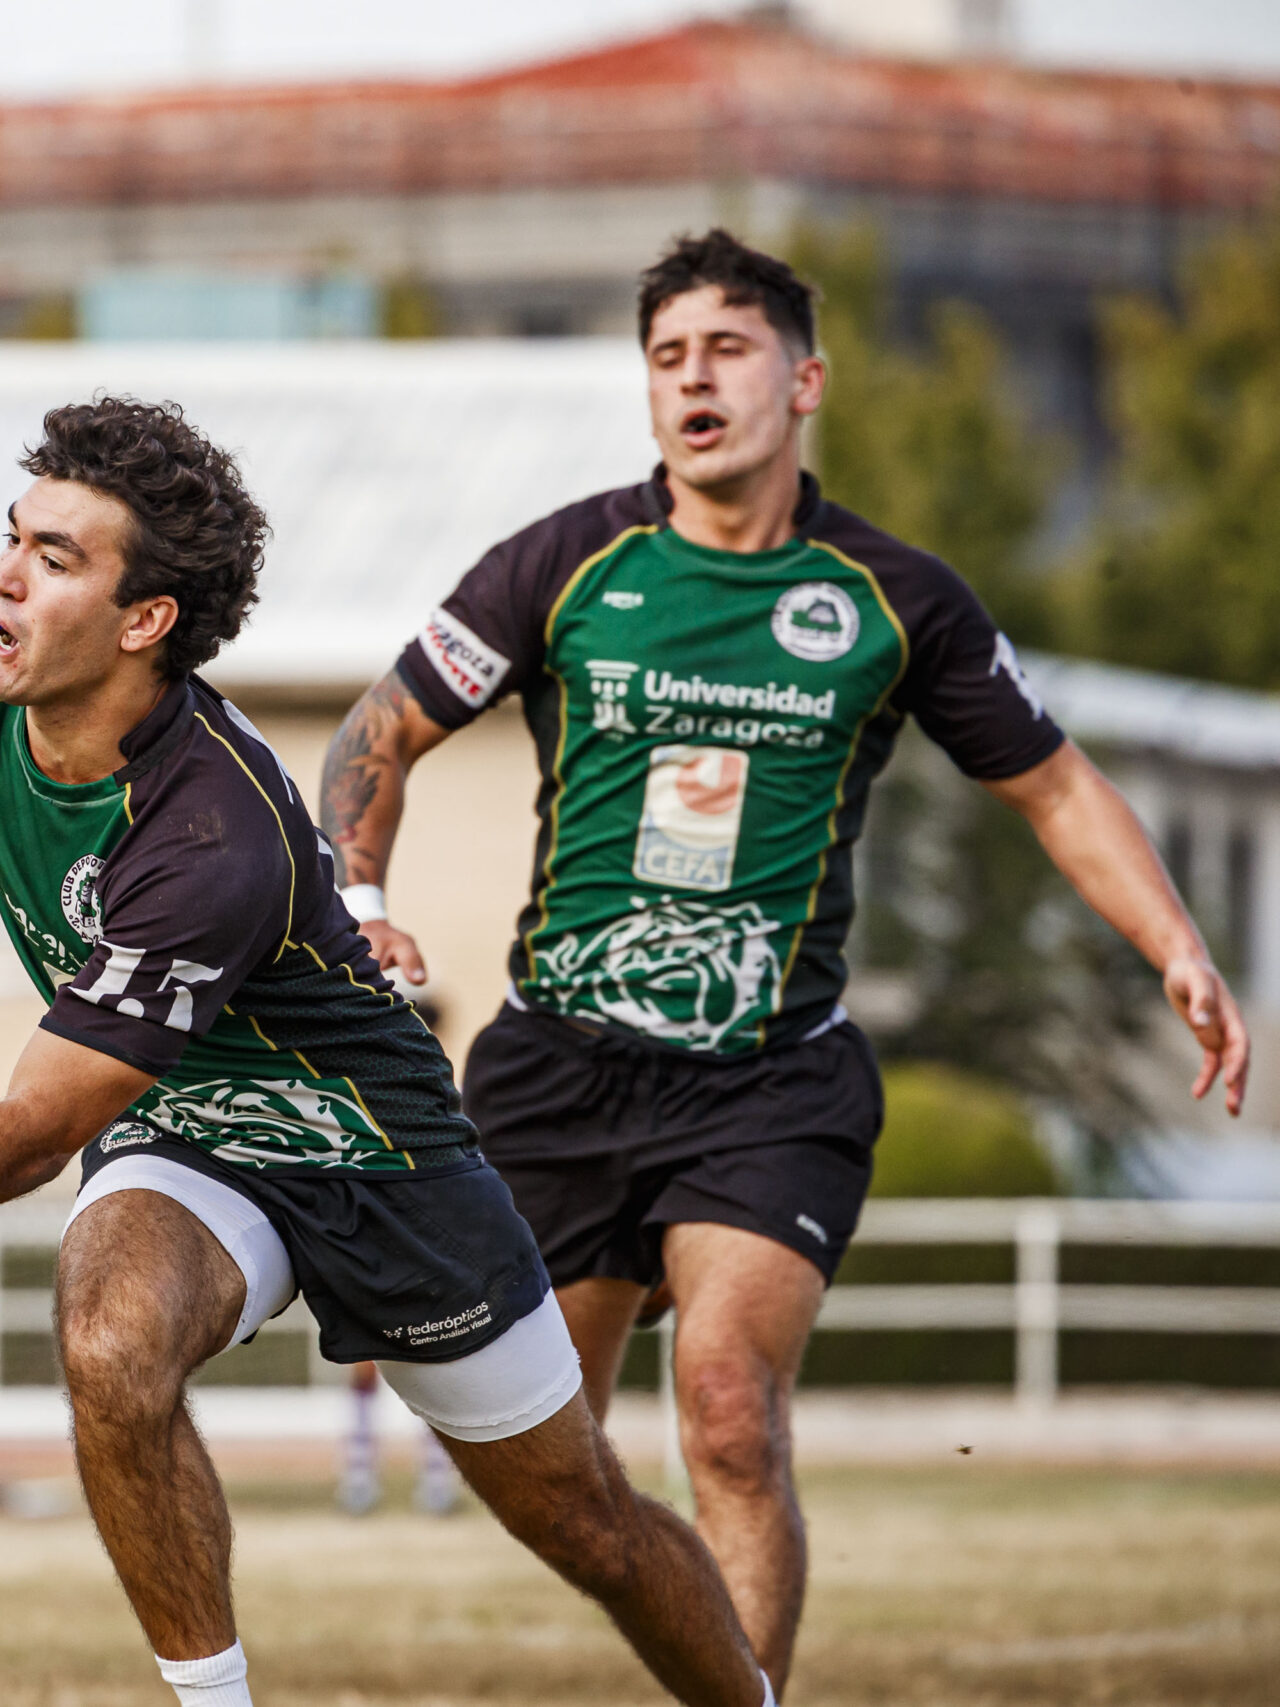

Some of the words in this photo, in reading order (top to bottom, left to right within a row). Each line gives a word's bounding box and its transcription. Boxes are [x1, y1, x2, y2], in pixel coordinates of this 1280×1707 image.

[644, 669, 836, 720] Universidad
[645, 704, 824, 748] Zaragoza
[643, 846, 721, 884] CEFA
[63, 876, 75, 907] CLUB
[407, 1301, 489, 1336] federópticos
[410, 1336, 438, 1346] Centro
[439, 1326, 470, 1341] Análisis
[470, 1314, 492, 1330] Visual
